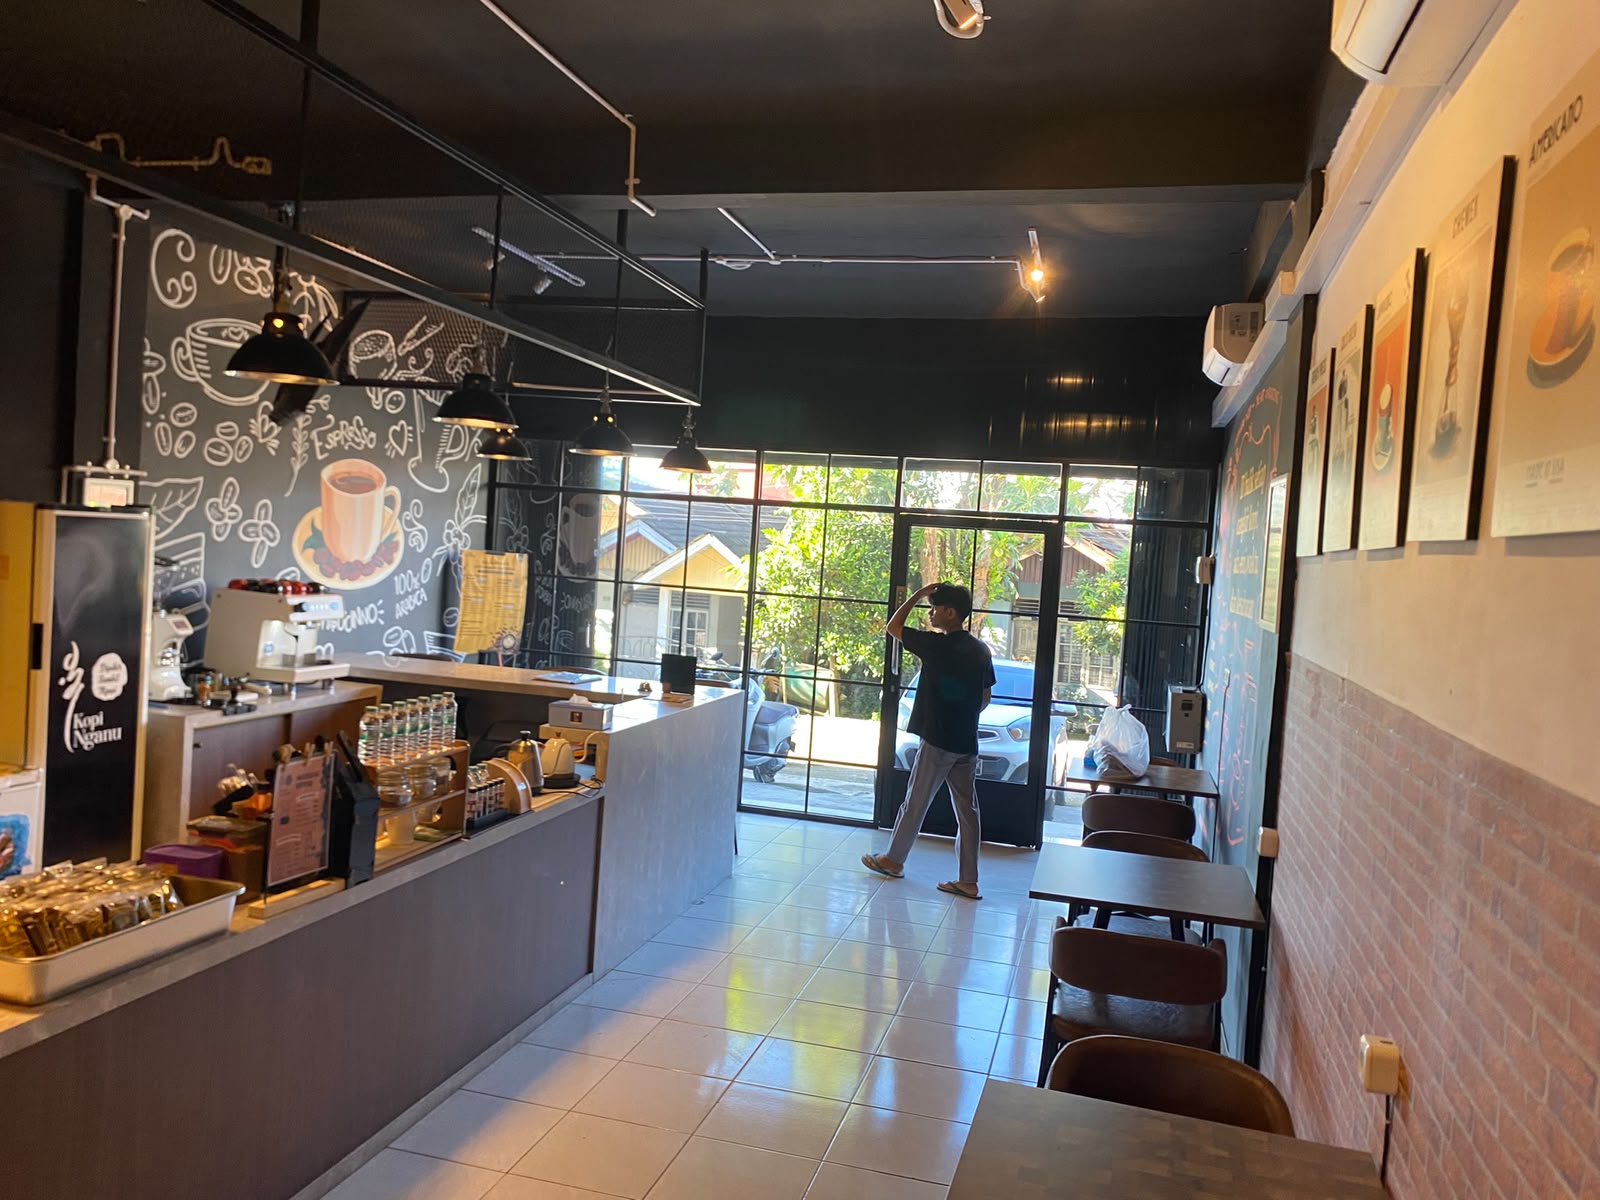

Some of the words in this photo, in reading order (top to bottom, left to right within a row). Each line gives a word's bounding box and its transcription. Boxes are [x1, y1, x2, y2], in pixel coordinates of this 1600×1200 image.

[1528, 94, 1583, 168] AMERICANO
[73, 711, 104, 731] Kopi
[73, 727, 122, 751] Nganu
